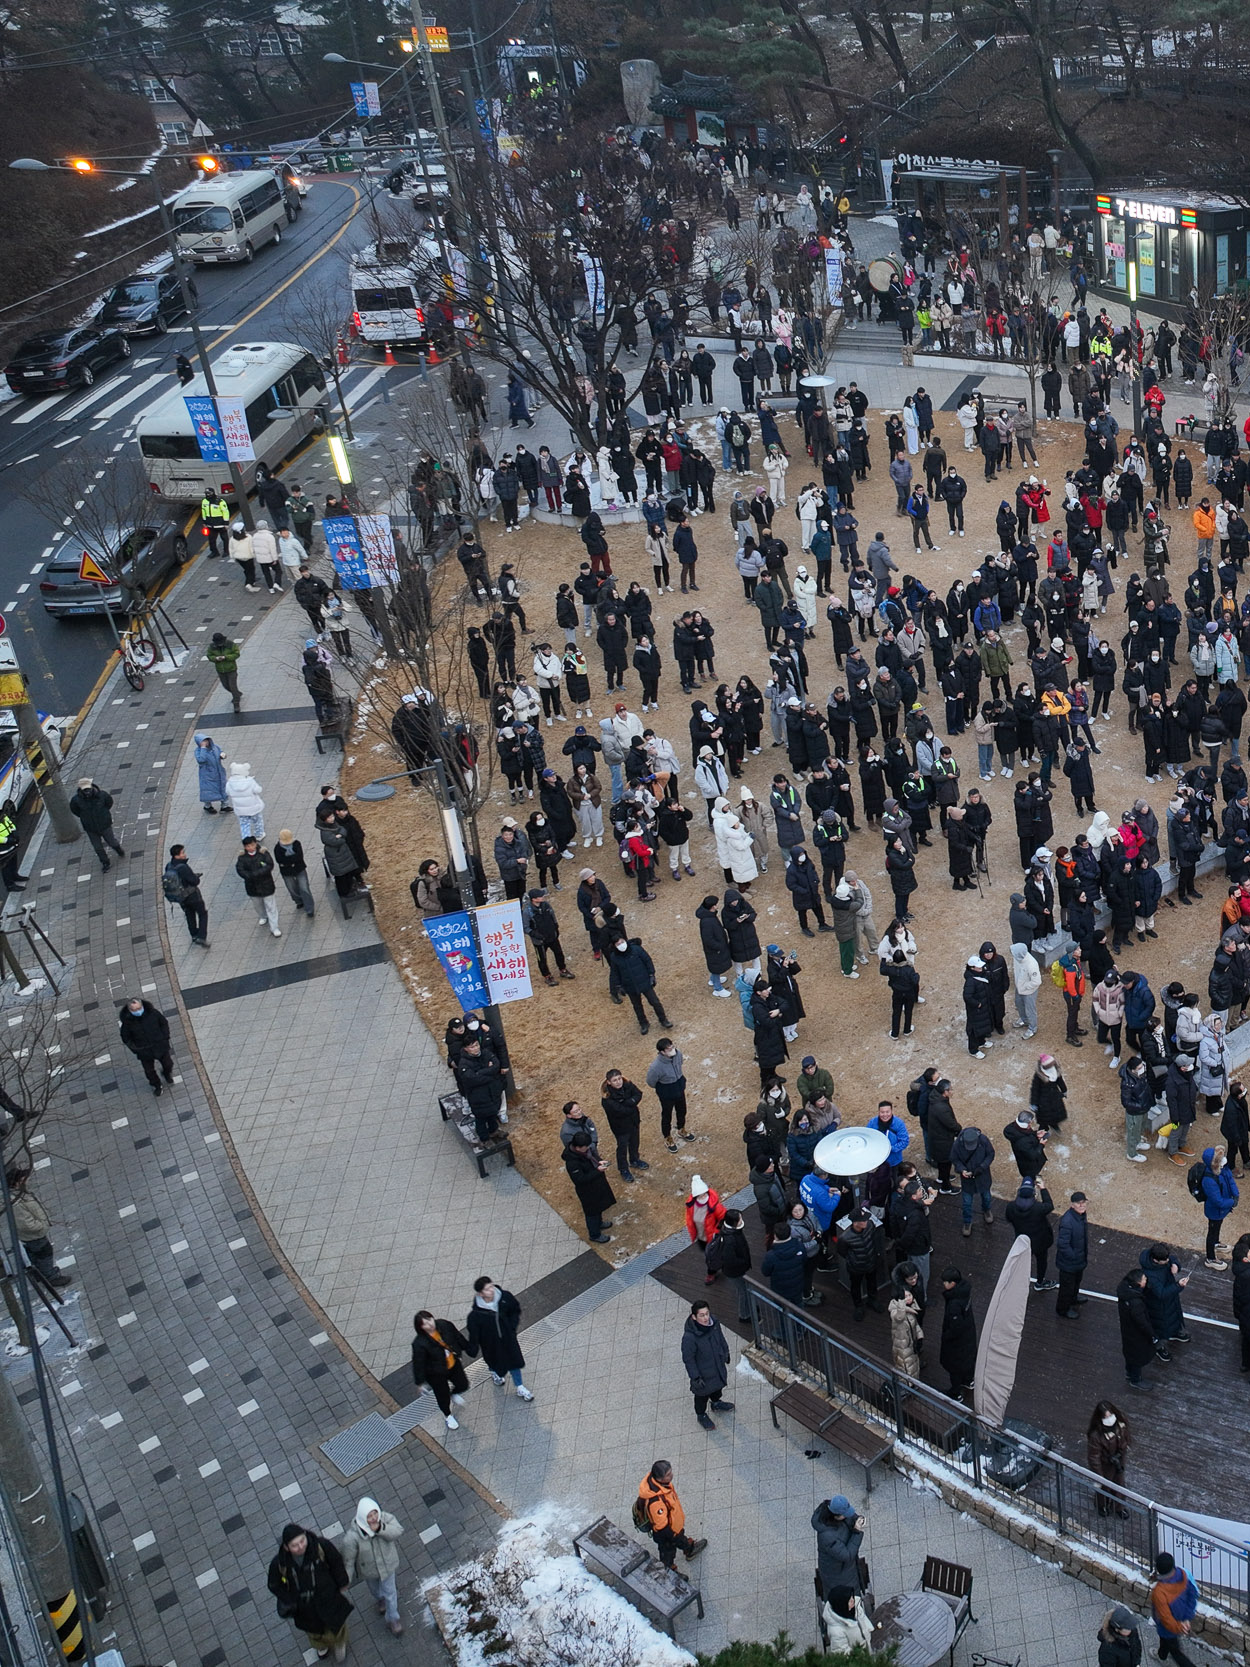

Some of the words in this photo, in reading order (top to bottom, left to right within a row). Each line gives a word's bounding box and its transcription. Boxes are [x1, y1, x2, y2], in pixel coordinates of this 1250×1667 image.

[226, 432, 250, 441] 새해
[331, 534, 357, 544] 새해
[484, 921, 515, 946] 행복
[487, 943, 523, 957] 가득한
[447, 954, 463, 974] 복
[486, 955, 526, 970] 새해
[491, 969, 527, 981] 되세요
